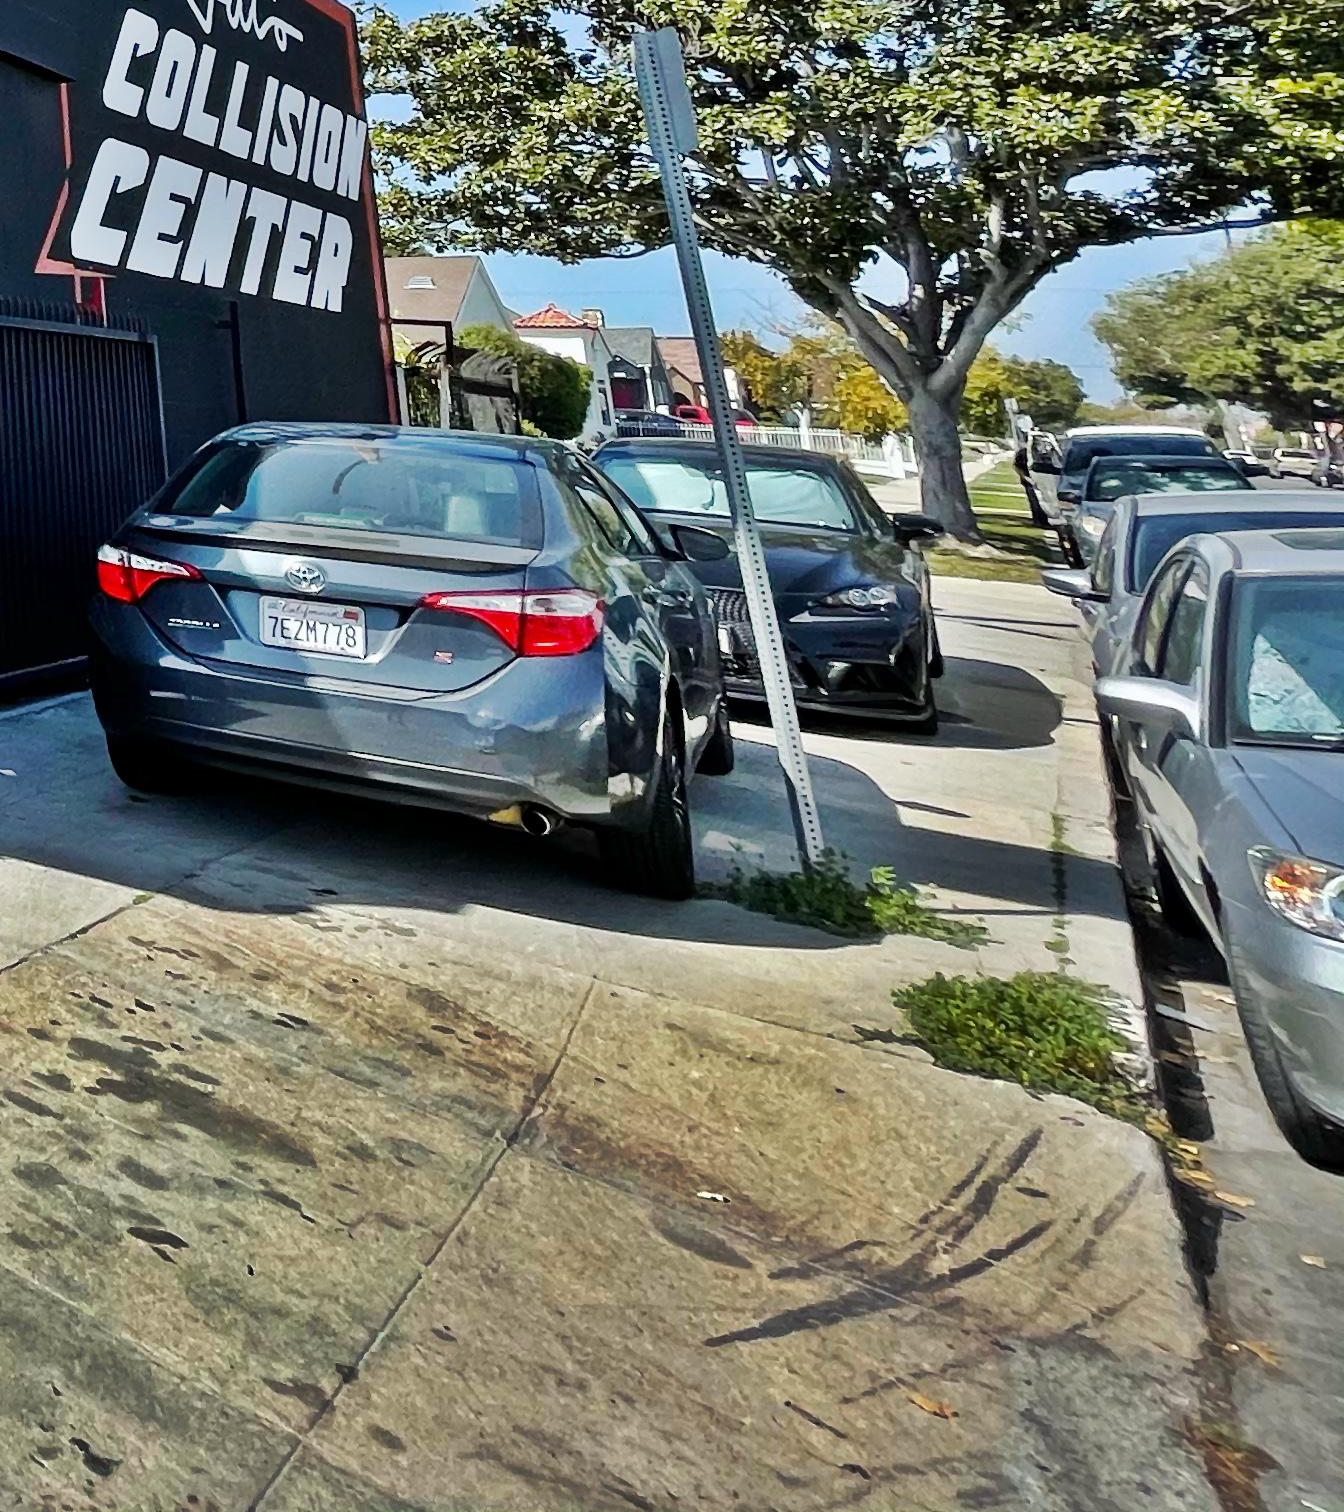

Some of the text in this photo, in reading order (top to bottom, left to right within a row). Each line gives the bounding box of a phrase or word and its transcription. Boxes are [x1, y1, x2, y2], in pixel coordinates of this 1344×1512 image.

[102, 8, 368, 201] COLLISION
[70, 137, 353, 313] CENTER
[267, 615, 357, 648] 7EZM778
